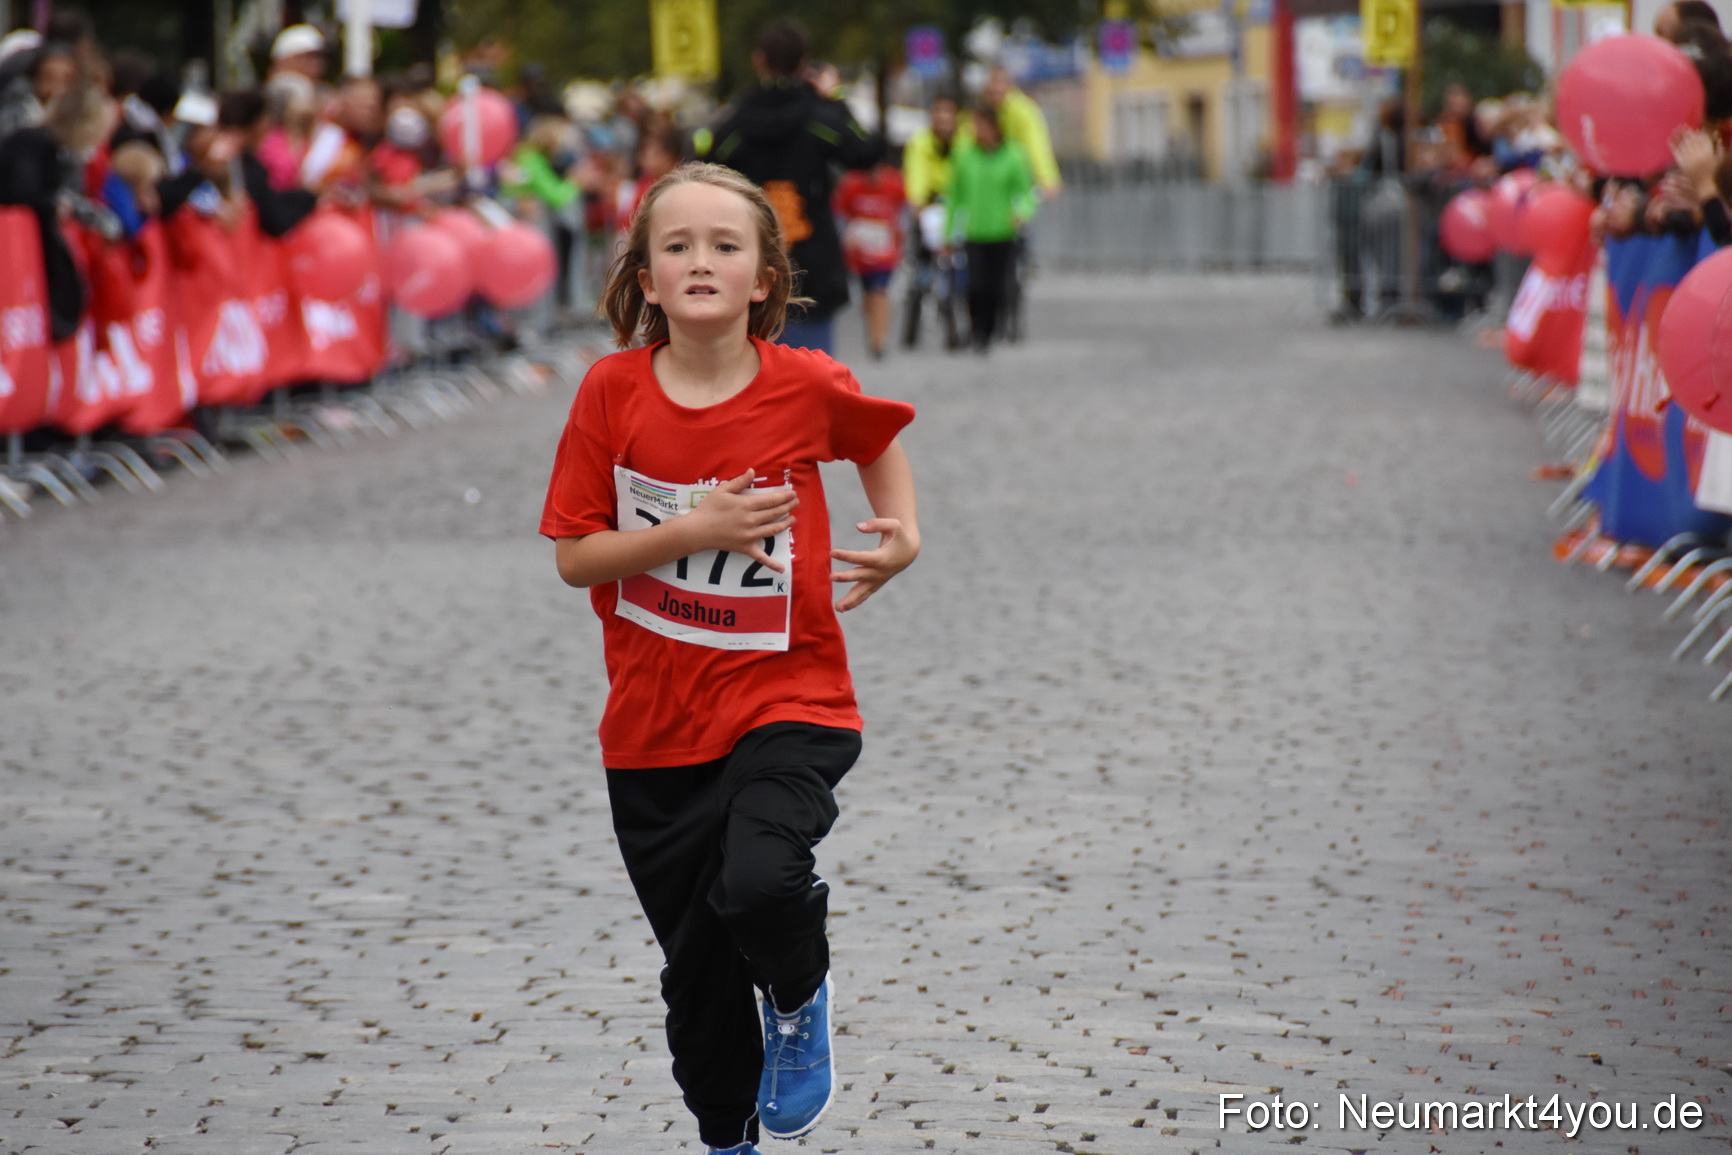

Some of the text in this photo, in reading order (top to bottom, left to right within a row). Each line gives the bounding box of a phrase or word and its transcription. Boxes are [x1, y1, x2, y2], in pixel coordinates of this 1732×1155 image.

[629, 486, 679, 511] NeuerMarkt
[777, 582, 785, 593] K
[657, 590, 736, 627] Joshua
